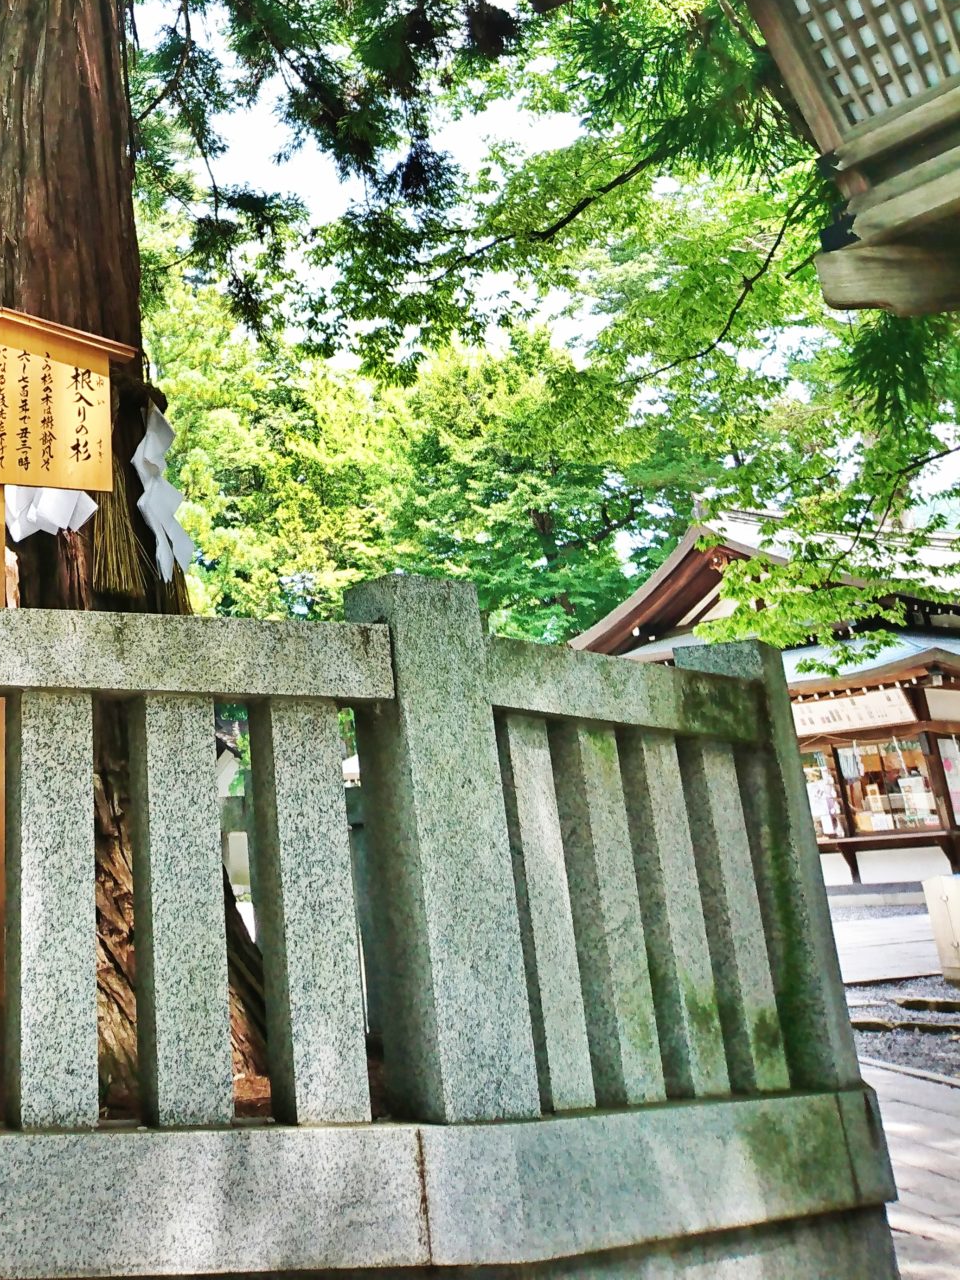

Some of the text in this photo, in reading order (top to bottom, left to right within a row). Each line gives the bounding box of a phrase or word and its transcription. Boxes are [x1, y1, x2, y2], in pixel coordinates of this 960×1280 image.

[39, 351, 57, 472] この杉の木は樹齢凡そ
[66, 366, 95, 463] 根入りの杉
